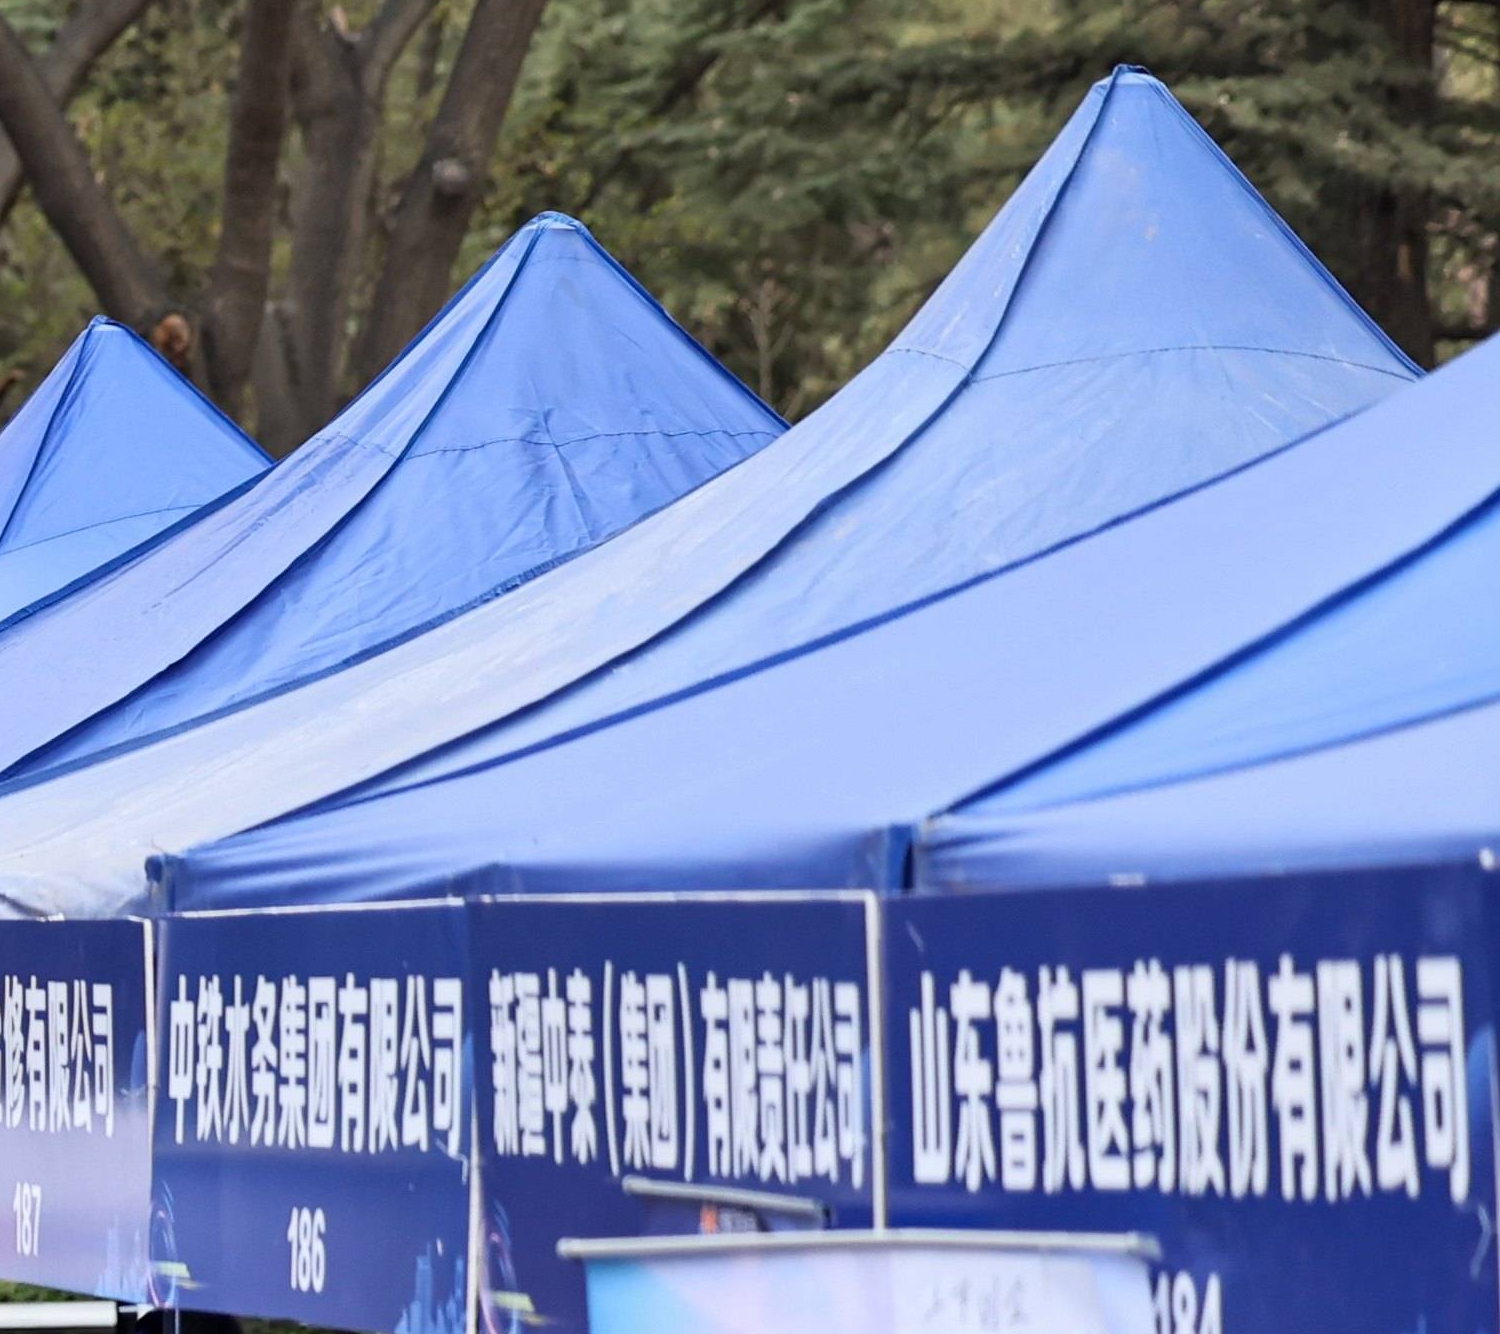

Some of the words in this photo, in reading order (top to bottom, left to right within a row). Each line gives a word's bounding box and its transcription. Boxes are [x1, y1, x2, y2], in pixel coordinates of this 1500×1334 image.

[168, 972, 464, 1154] 中铁水务集团有限公司
[910, 953, 1471, 1204] 山东鲁抗医药股份有限公司
[13, 1181, 43, 1258] 187
[286, 1206, 327, 1294] 186
